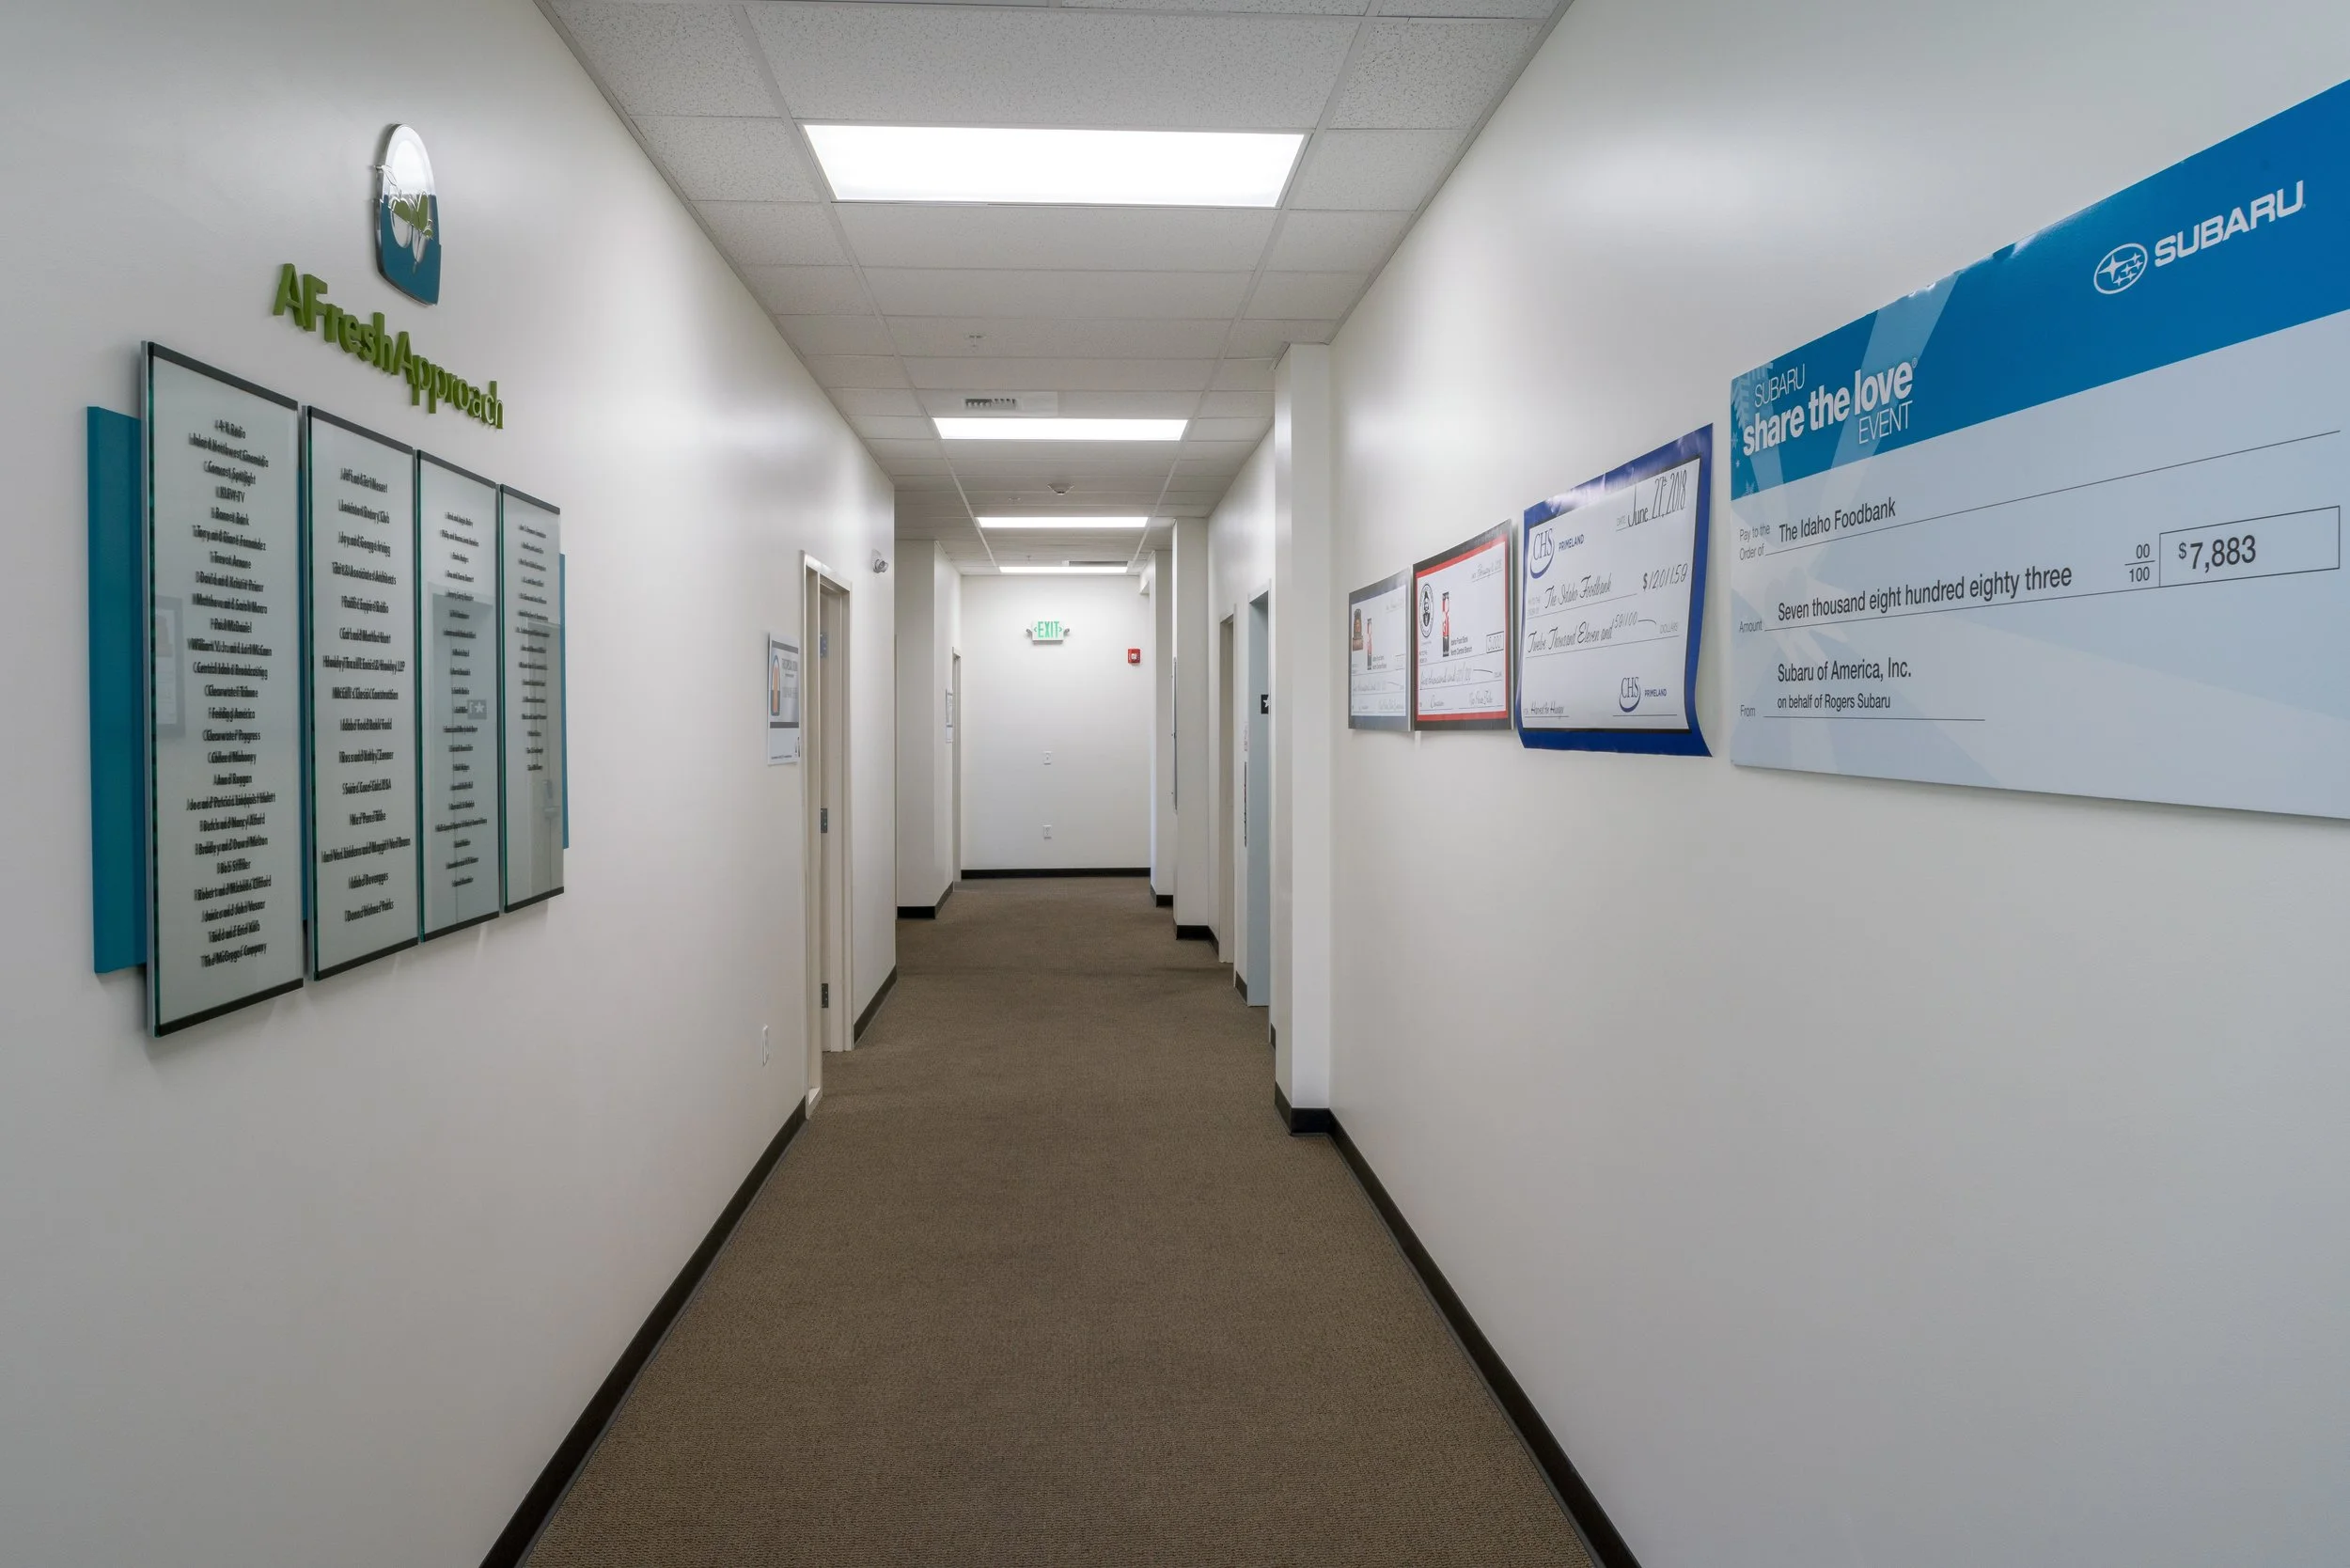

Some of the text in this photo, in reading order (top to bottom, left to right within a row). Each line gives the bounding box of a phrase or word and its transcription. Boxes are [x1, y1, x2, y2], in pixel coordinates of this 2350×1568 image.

[2154, 180, 2305, 268] SUBARU
[1754, 363, 1806, 408] SUBARU
[1743, 361, 1914, 456] share the love
[1858, 400, 1914, 445] EVENT
[1627, 481, 1649, 527] June
[1668, 469, 1687, 517] 2018
[1778, 496, 1896, 542] The Idaho Foodbank
[1559, 534, 1585, 552] PRIMELAND
[1739, 523, 1771, 542] Pay to the
[1533, 527, 1553, 561] CHS
[1739, 543, 1764, 561] Order of
[2136, 543, 2151, 560] 00
[2129, 566, 2151, 583] 100
[1544, 572, 1612, 608] The Idaho Foodbank
[1778, 566, 2073, 621] Seven thousand eight hundred eighty three
[1038, 620, 1059, 638] EXIT
[1739, 619, 1762, 634] Amount
[1778, 657, 1912, 682] Subaru of America, Inc.
[1622, 676, 1640, 698] CHS
[1644, 688, 1668, 698] PRIMELAND
[1740, 705, 1756, 717] From
[1777, 693, 1891, 713] on behalf of Rogers Subaru
